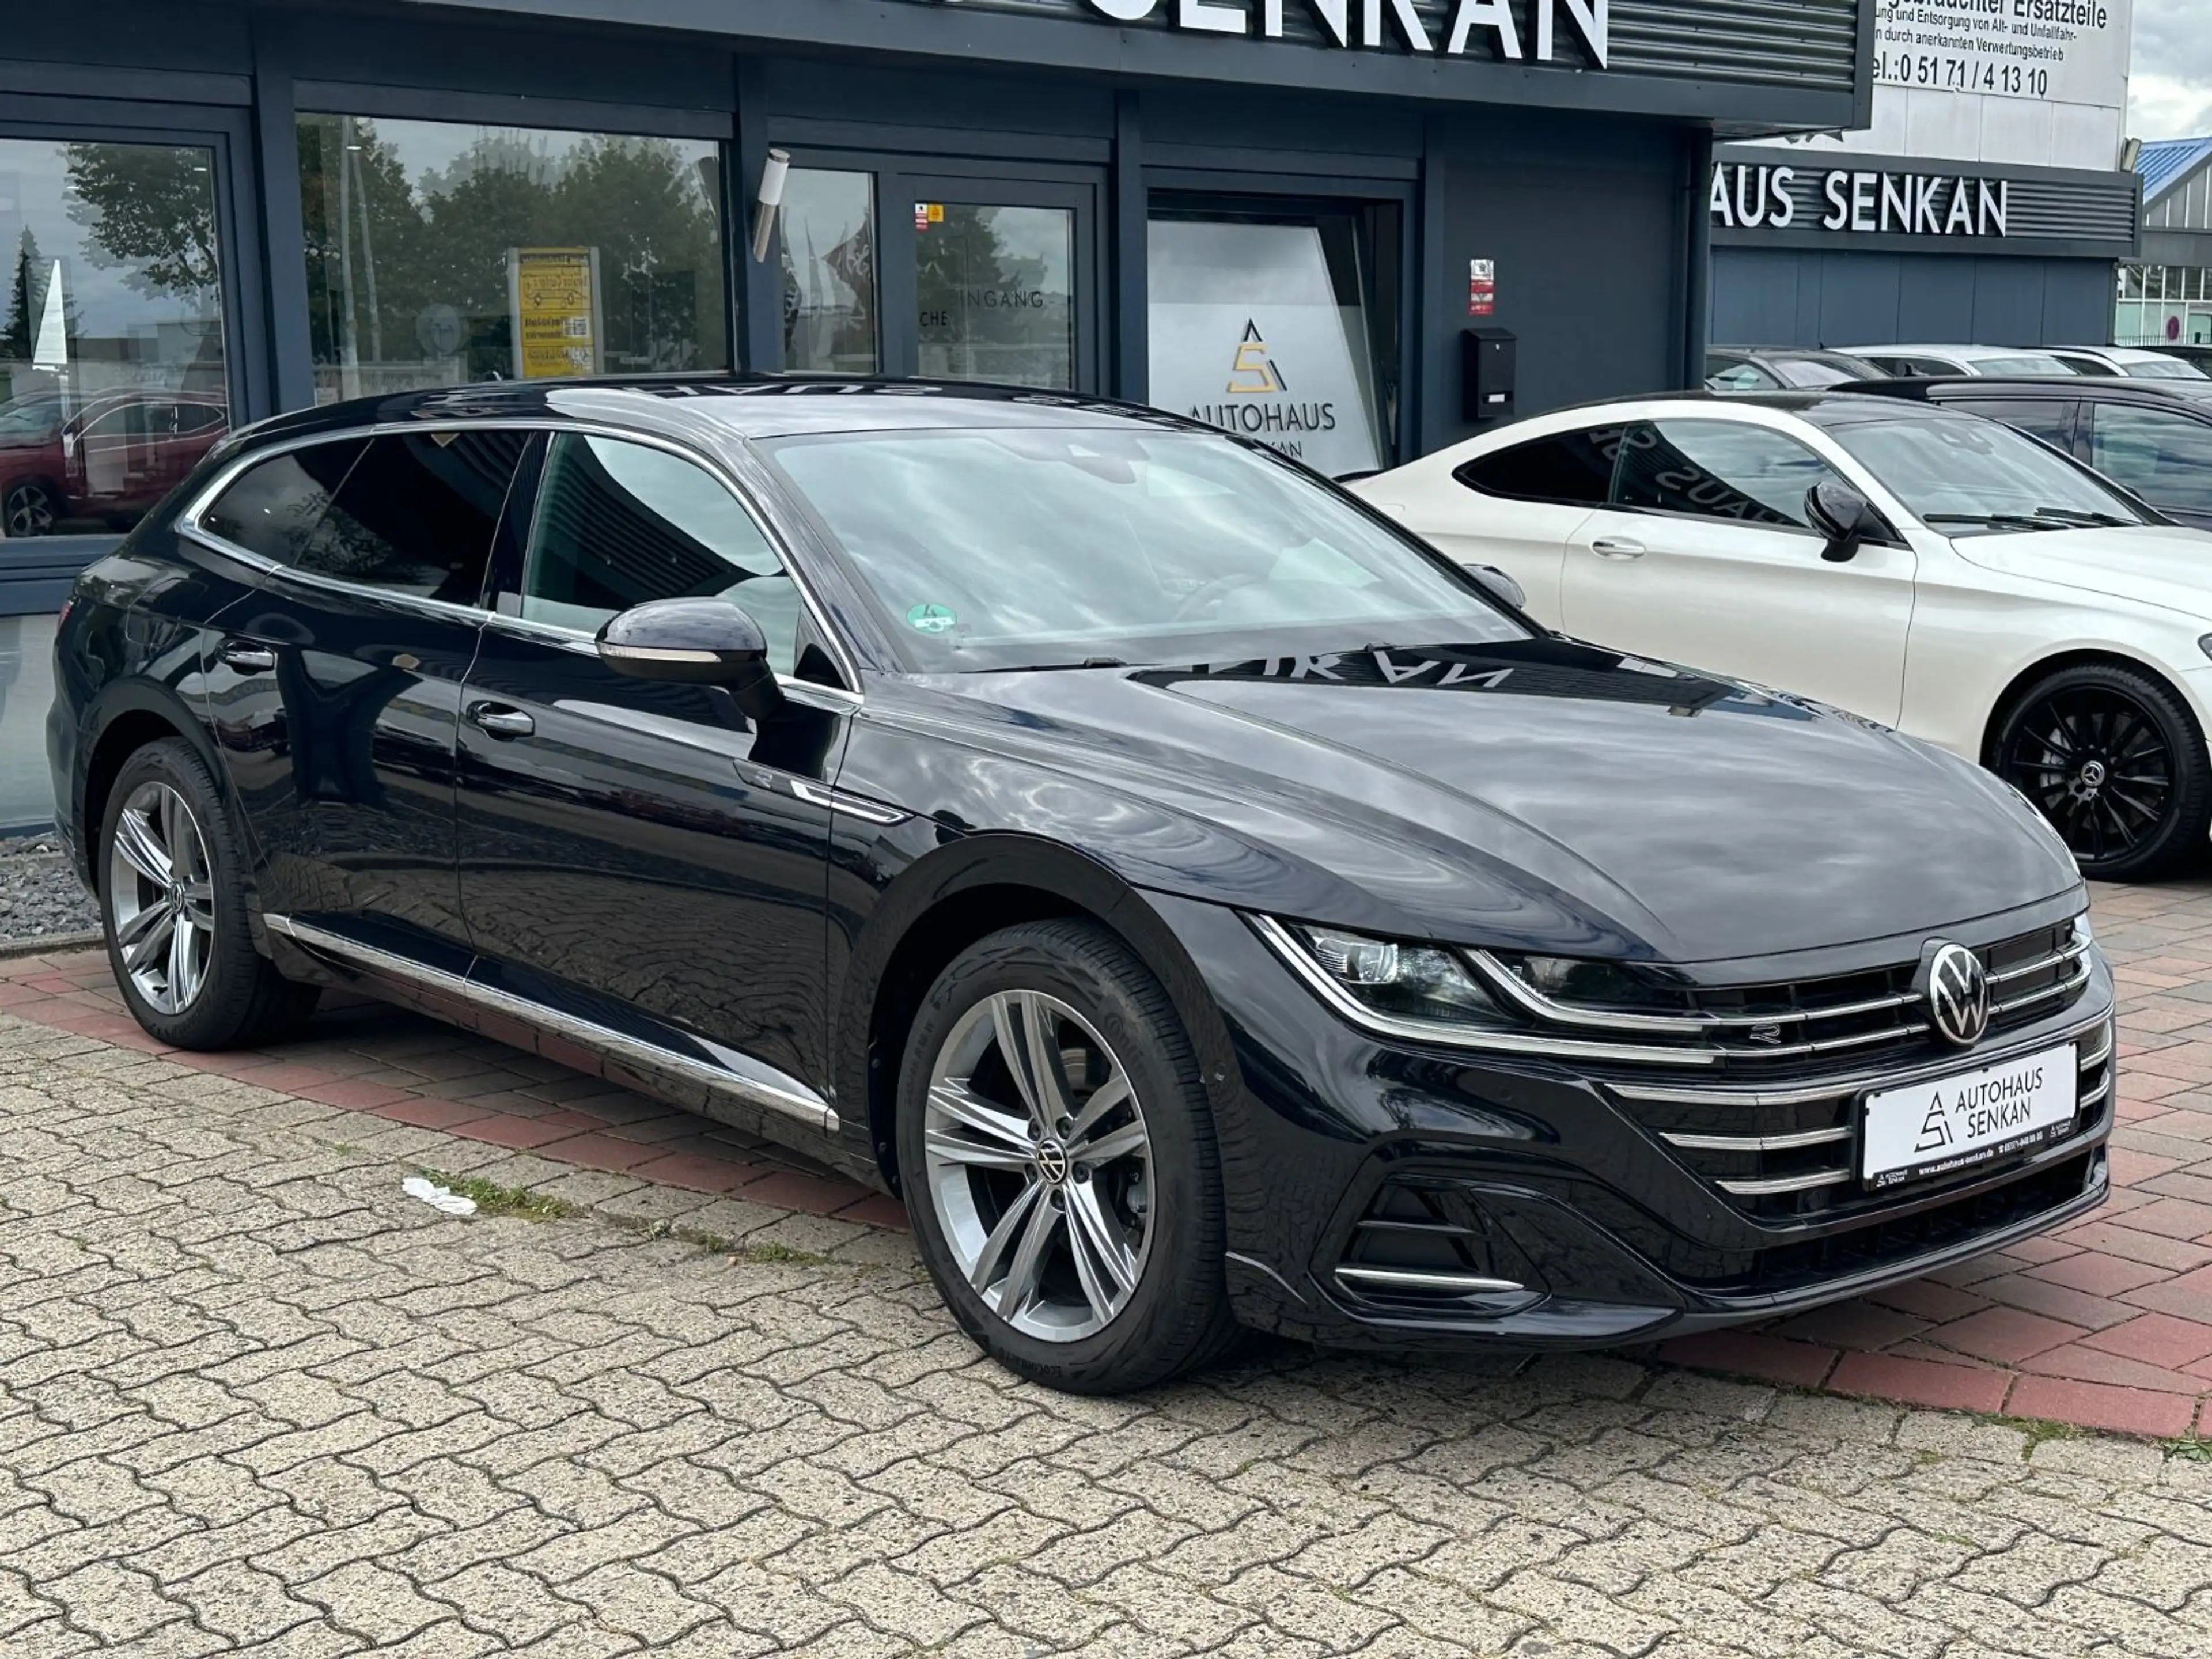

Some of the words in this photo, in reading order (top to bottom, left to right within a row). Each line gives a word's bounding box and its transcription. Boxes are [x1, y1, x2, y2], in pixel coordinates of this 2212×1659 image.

[1896, 8, 1914, 22] und
[1918, 9, 1971, 32] Entsorgung
[1973, 18, 1989, 31] von
[1992, 18, 2008, 32] Alt-
[2011, 22, 2028, 36] und
[2014, 0, 2107, 29] Ersatzteile
[1884, 26, 1913, 43] durch
[1916, 33, 1974, 51] anerkannten
[1976, 37, 2063, 61] Verwertungsbetrieb
[1917, 55, 1938, 85] 51
[1946, 59, 1965, 88] 71
[1983, 62, 1994, 90] 4
[2001, 64, 2021, 93] 13
[2028, 67, 2047, 96] 10
[1710, 162, 1794, 228] AUS
[1823, 171, 2008, 237] SENKAN
[1955, 1067, 2043, 1113] AUTOHAUS
[1967, 1097, 2031, 1139] SENKAN
